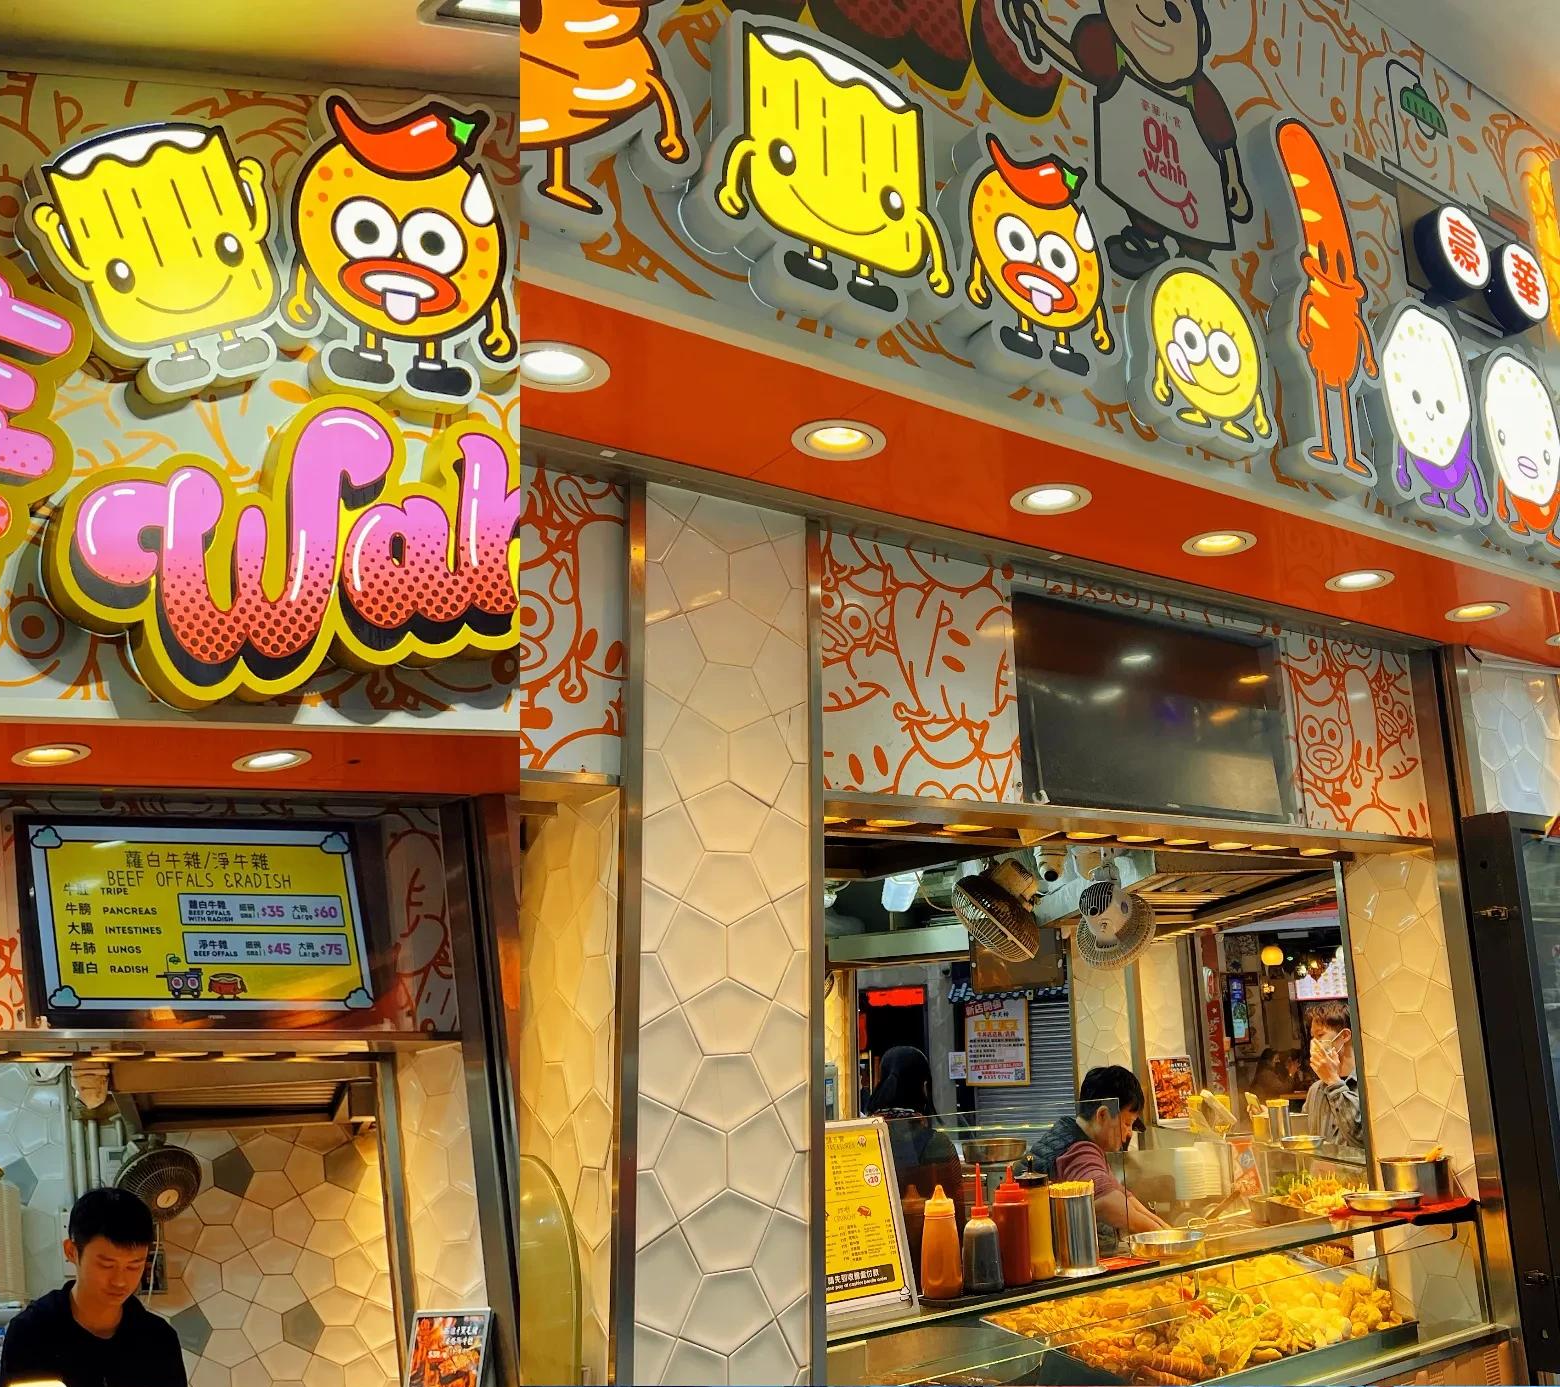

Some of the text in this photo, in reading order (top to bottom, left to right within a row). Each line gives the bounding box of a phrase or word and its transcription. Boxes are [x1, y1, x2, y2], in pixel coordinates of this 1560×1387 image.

[1143, 117, 1179, 163] Oh
[1143, 148, 1187, 188] Wahh
[125, 850, 271, 871] 蘿白牛雜/淨牛雜
[107, 870, 144, 887] BEEF
[156, 871, 214, 888] OFFALS
[103, 907, 157, 915] PANCREAS
[262, 906, 284, 917] $35
[314, 907, 337, 918] $60
[68, 922, 93, 935] 大腸
[70, 942, 96, 954] 牛肺
[268, 943, 291, 955] $45
[321, 944, 342, 955] $75
